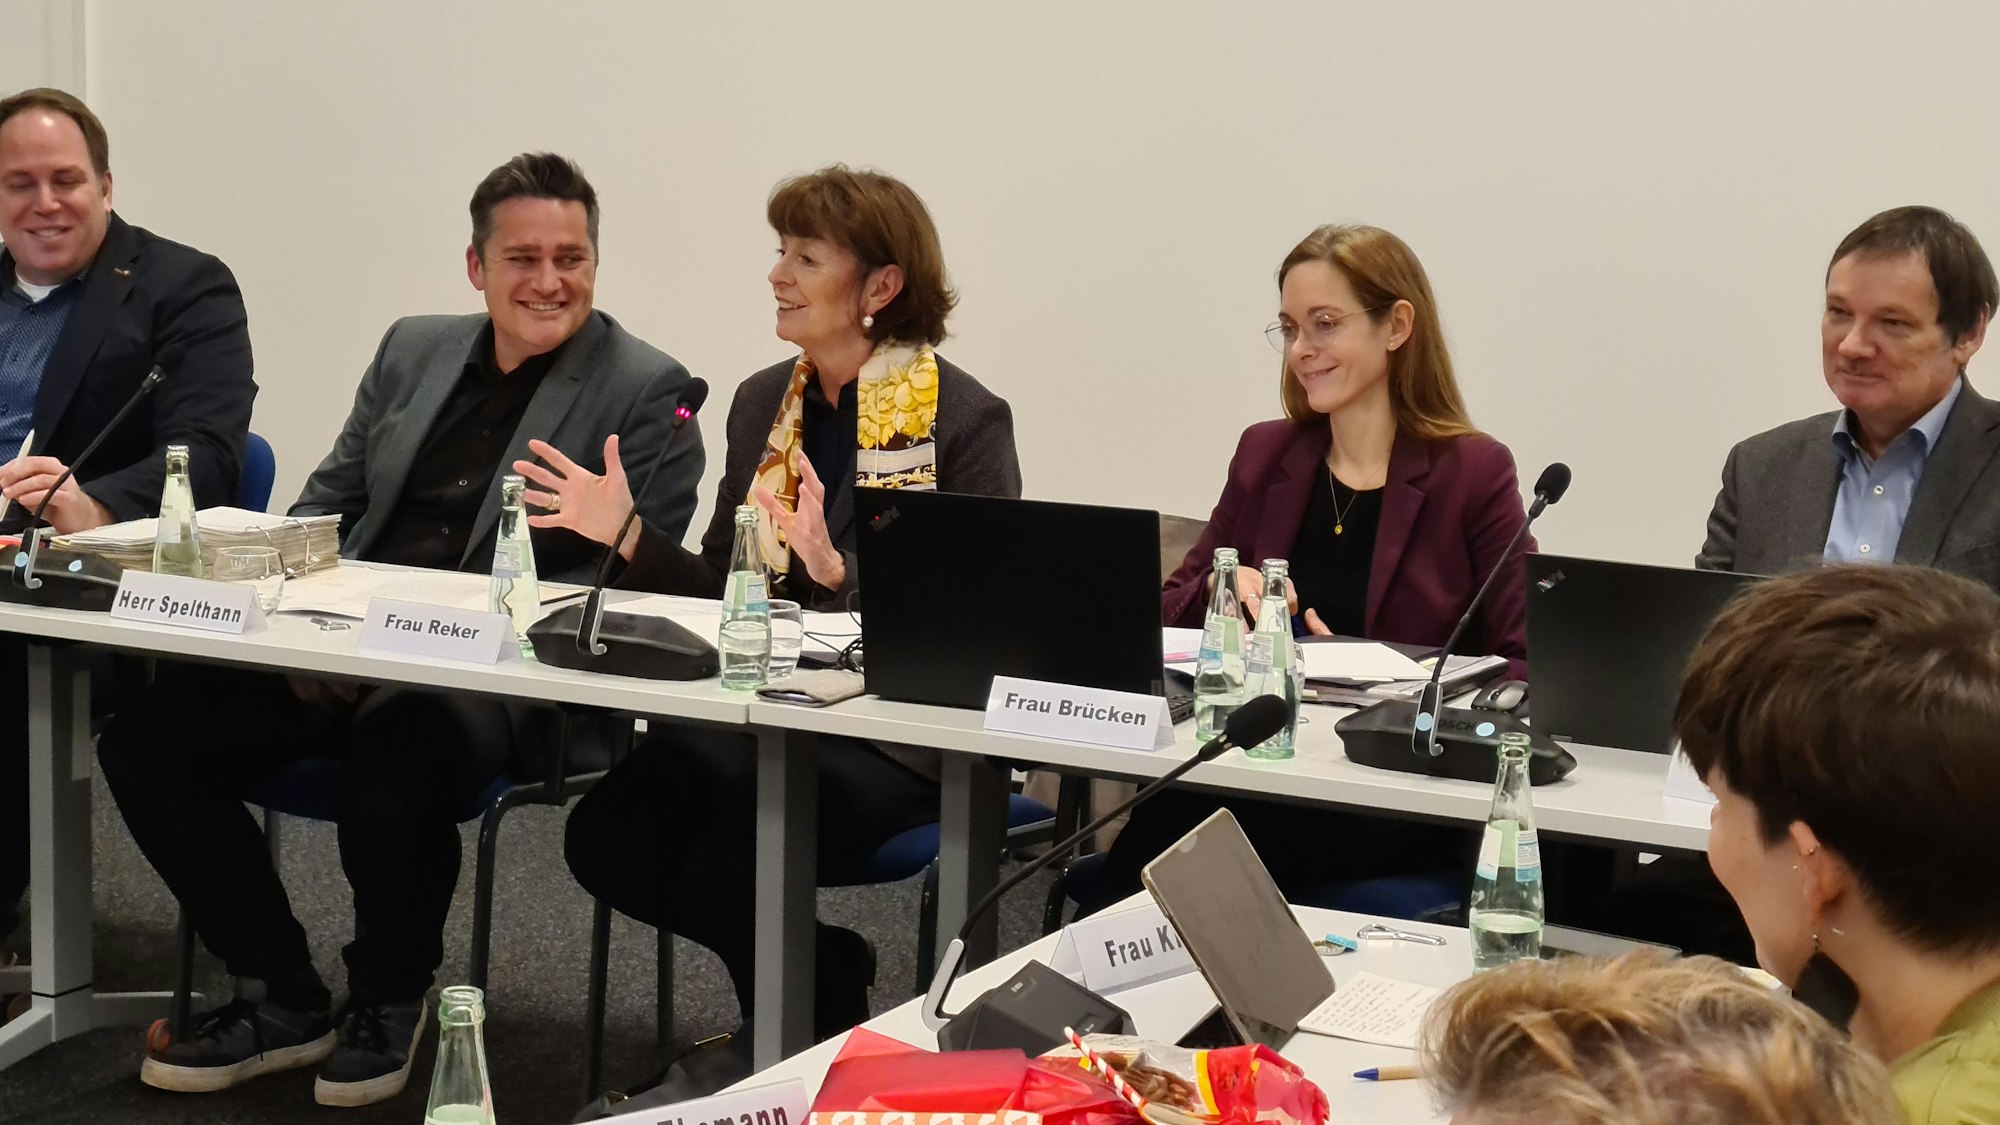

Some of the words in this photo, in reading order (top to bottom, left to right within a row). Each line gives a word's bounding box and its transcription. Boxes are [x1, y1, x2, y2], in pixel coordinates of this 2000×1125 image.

[118, 590, 156, 611] Herr
[159, 594, 242, 625] Spelthann
[384, 613, 423, 634] Frau
[428, 619, 481, 640] Reker
[1005, 691, 1052, 715] Frau
[1058, 698, 1147, 727] Brücken
[1104, 936, 1154, 968] Frau
